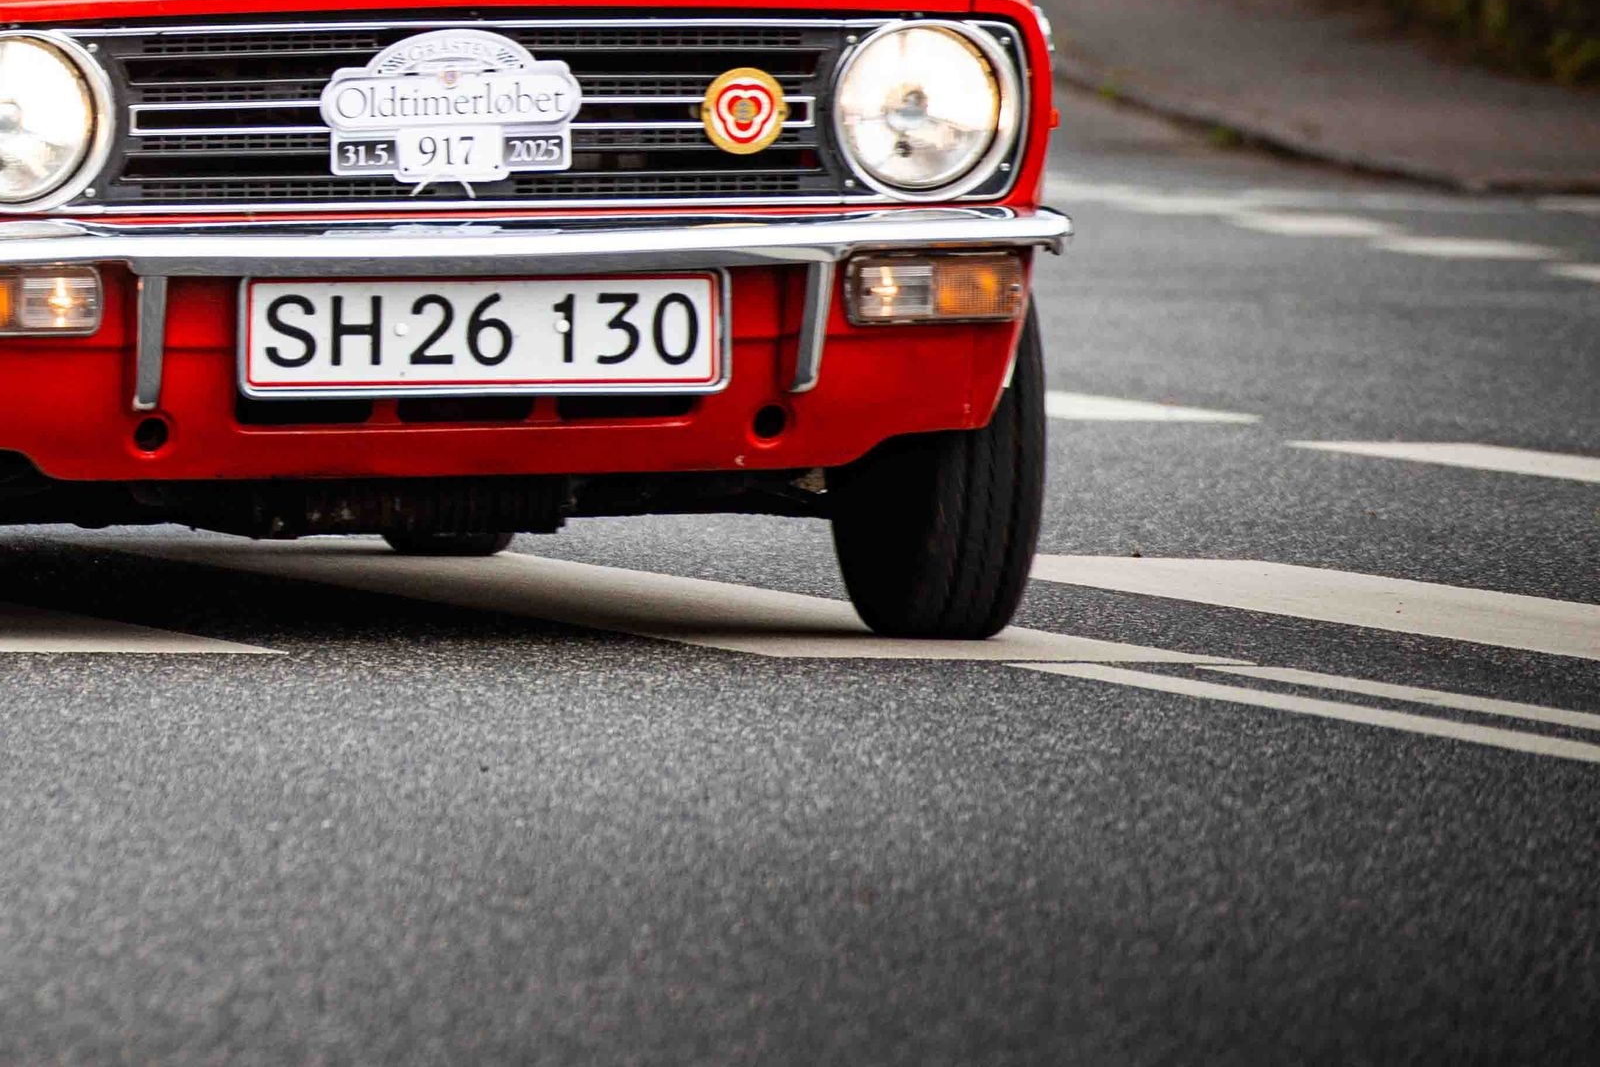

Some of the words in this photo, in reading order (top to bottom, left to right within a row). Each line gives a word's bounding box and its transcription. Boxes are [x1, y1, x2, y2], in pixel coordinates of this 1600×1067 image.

[342, 145, 394, 166] 31.5.
[419, 136, 474, 166] 917
[509, 139, 560, 162] 2025
[264, 294, 382, 367] SH
[409, 292, 513, 366] 26
[552, 292, 700, 366] 130
